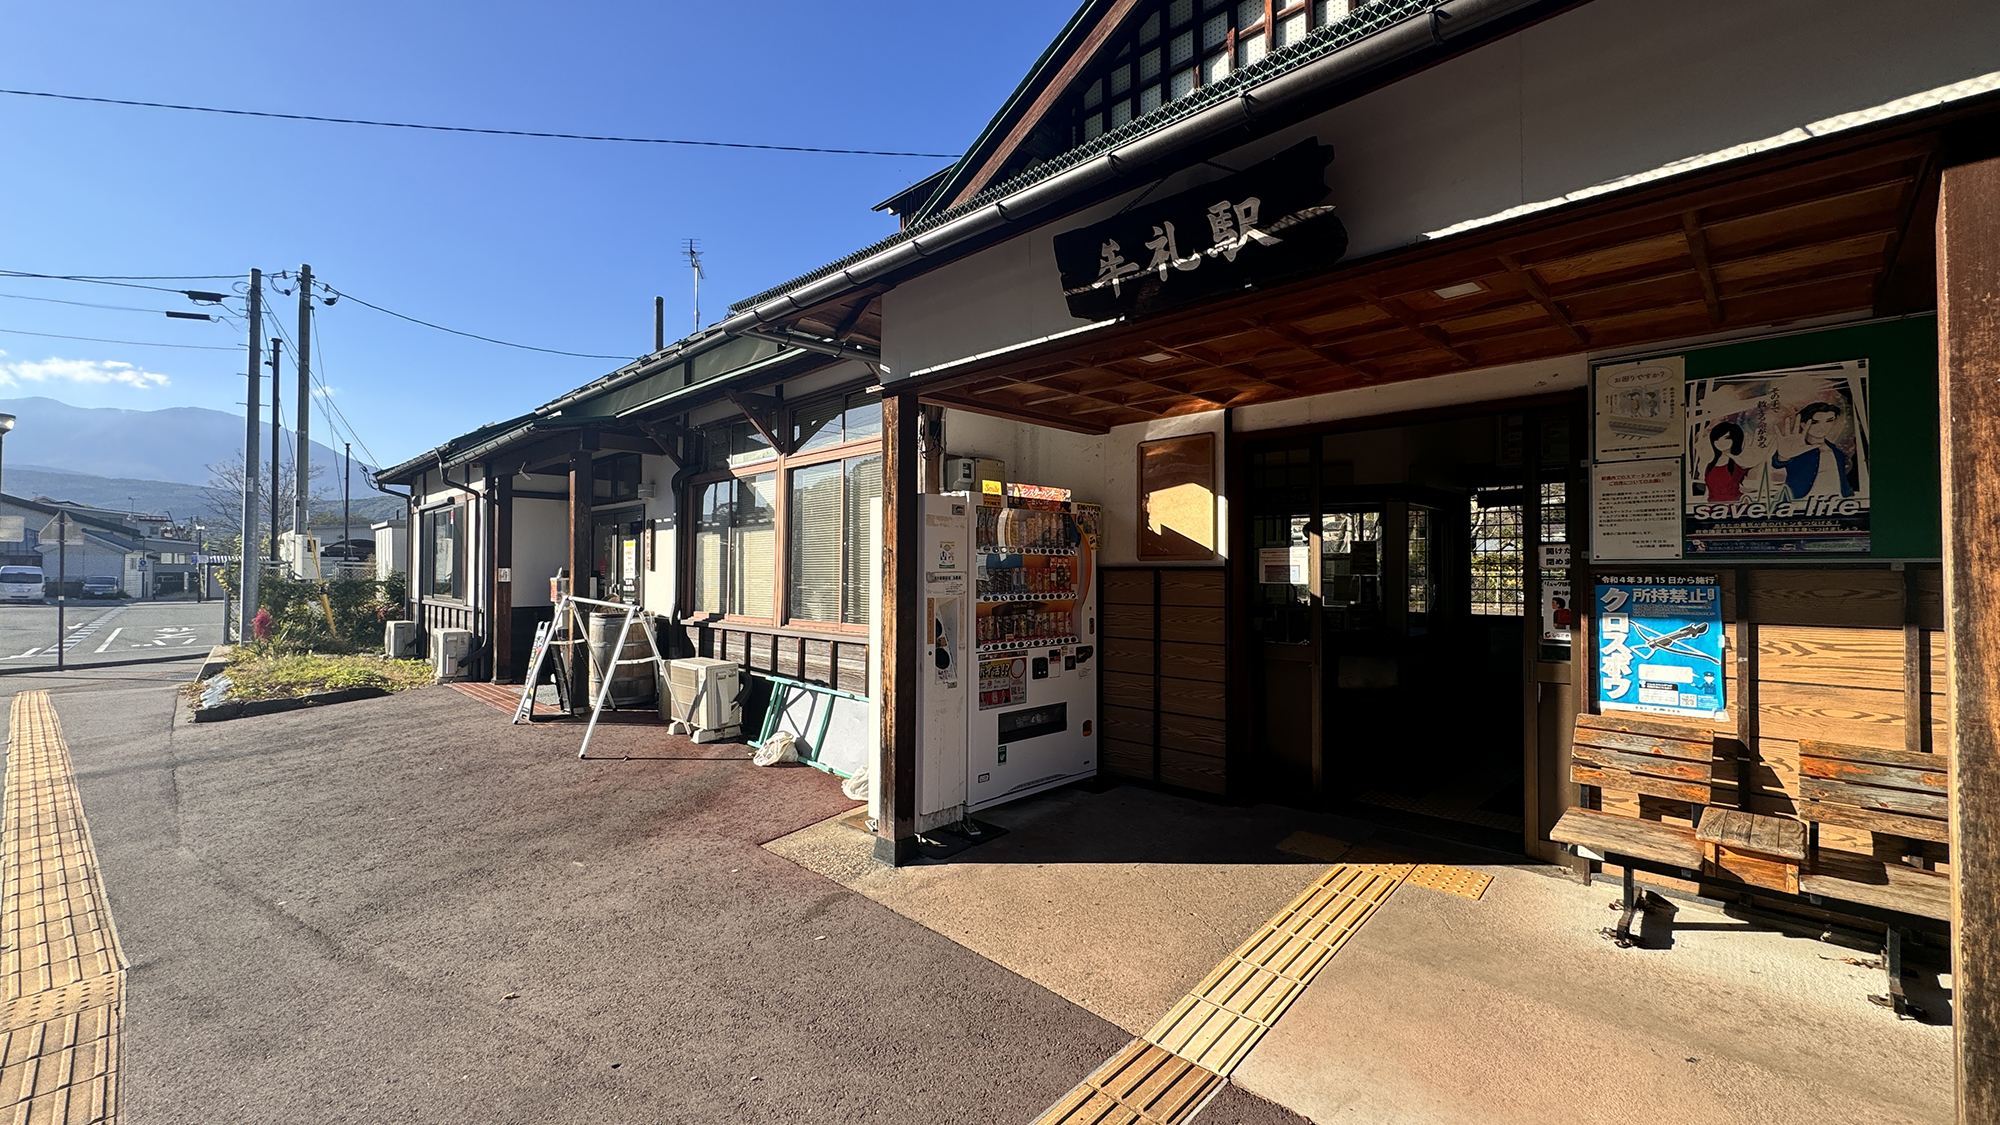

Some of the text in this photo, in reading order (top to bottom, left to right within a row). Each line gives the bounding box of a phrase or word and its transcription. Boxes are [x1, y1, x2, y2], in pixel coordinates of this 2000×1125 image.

[1092, 197, 1283, 299] 牟礼駅
[1614, 371, 1665, 383] お困りですか?
[1757, 400, 1767, 449] 救える命がある
[1020, 487, 1059, 498] モンスターハンター
[1694, 494, 1860, 520] save a life
[1601, 576, 1715, 585] 令和4年3月15日から施行
[1632, 588, 1708, 604] 所持禁止
[1600, 587, 1632, 700] クロスボウ
